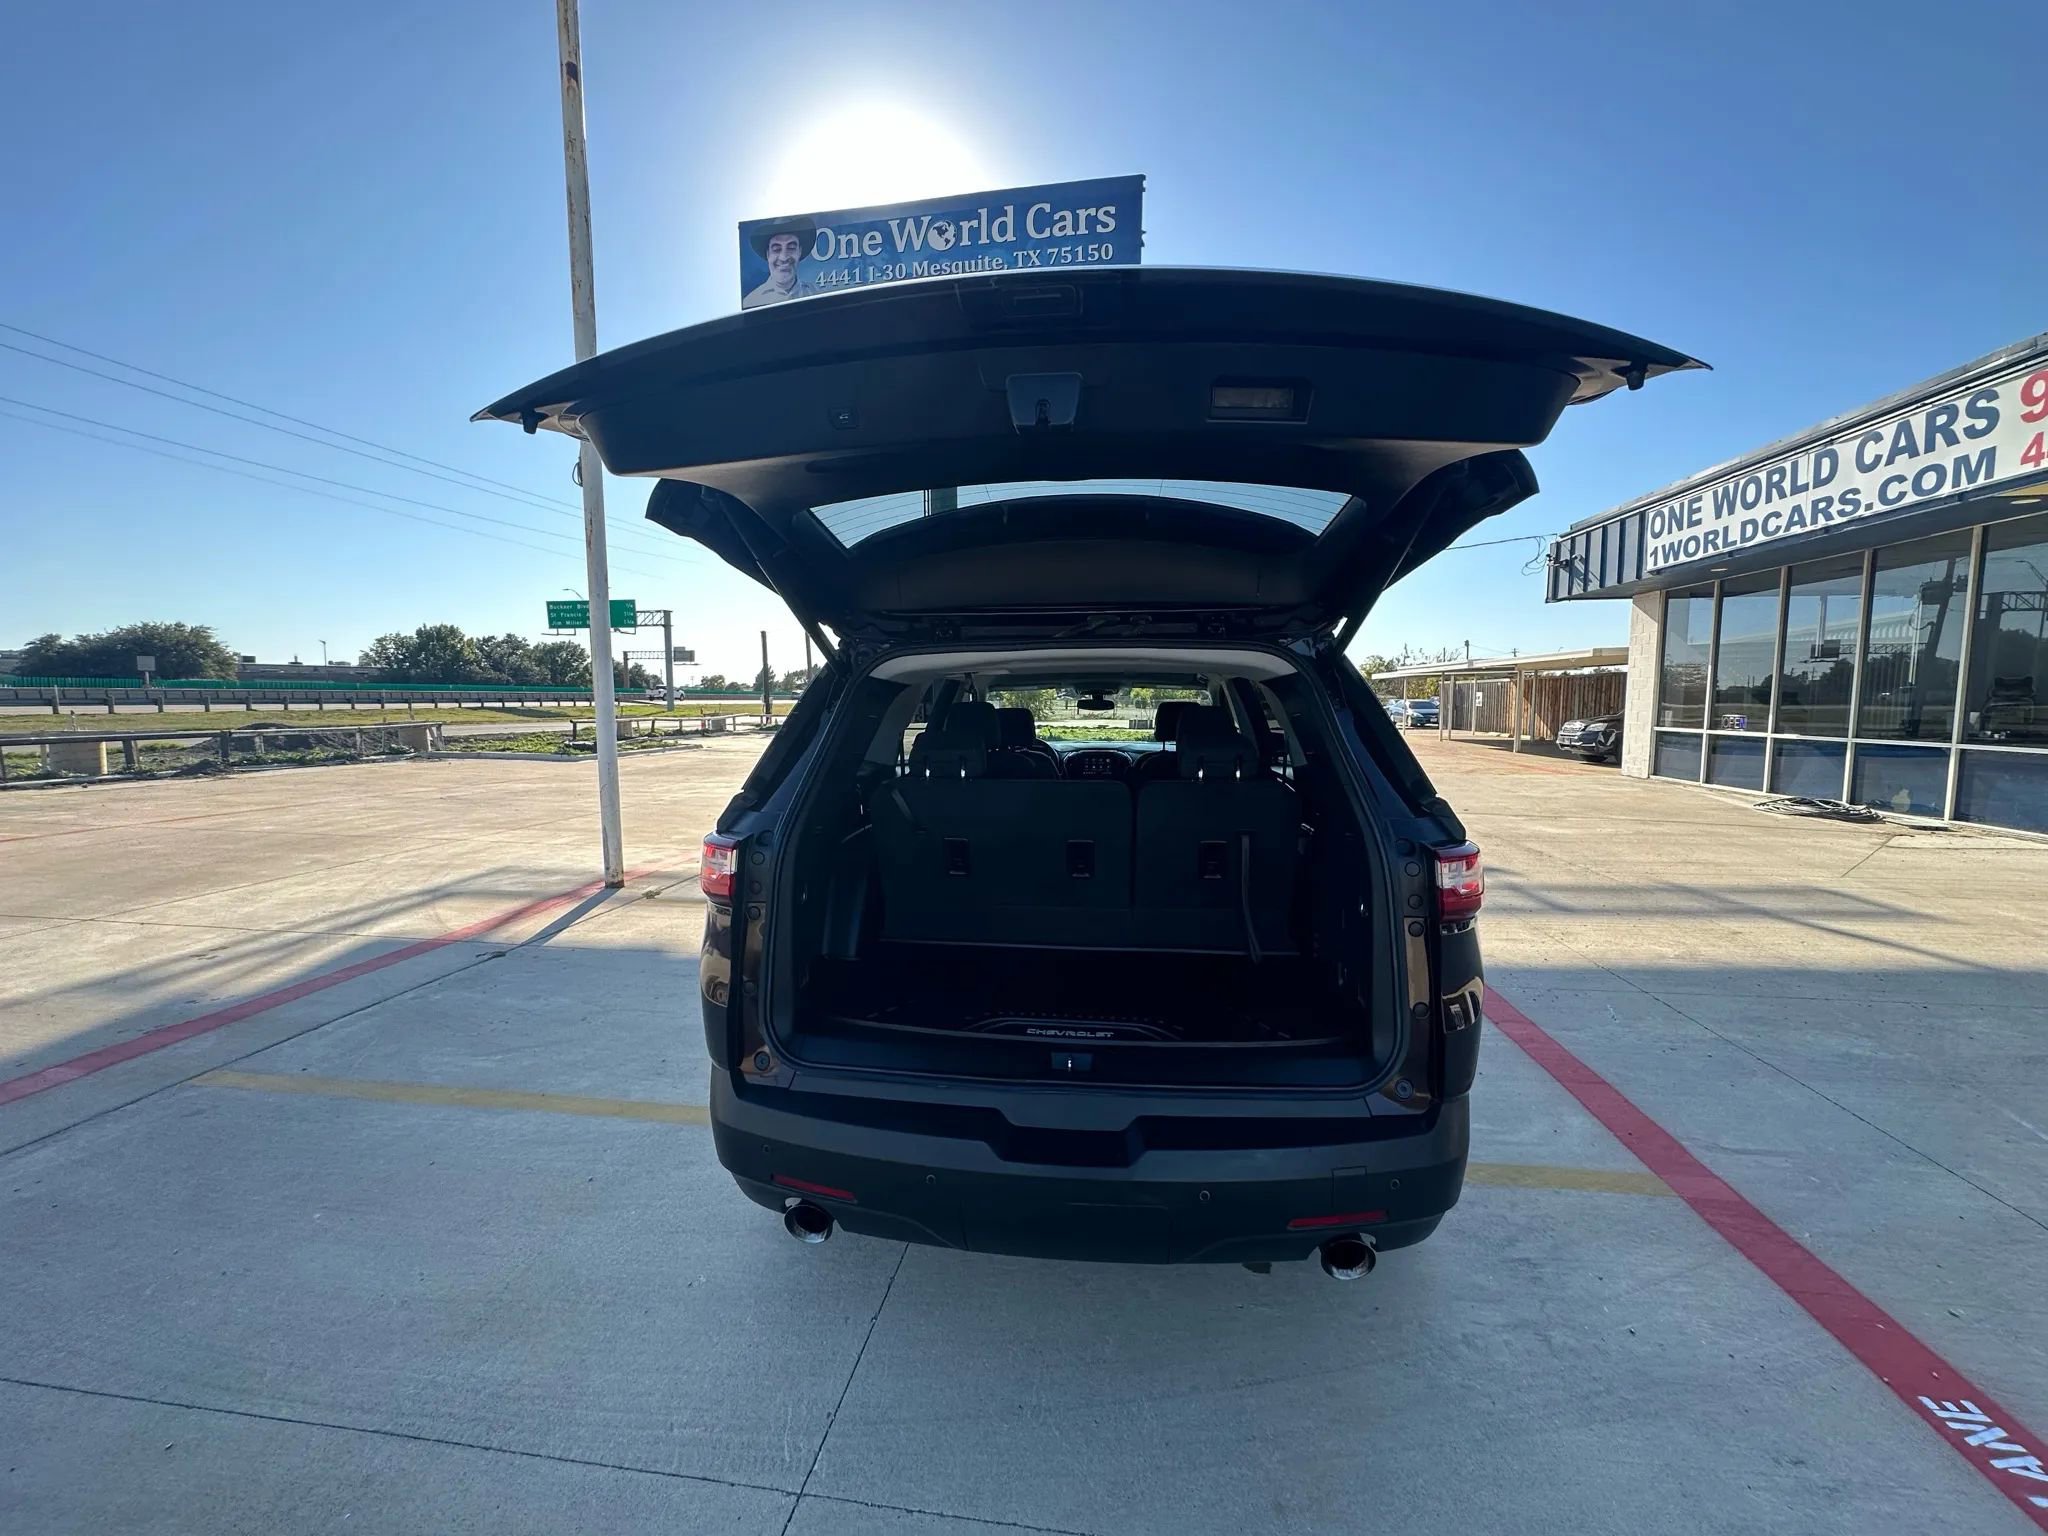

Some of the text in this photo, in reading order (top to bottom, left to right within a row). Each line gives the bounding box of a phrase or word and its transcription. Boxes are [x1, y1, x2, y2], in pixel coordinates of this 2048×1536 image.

[812, 226, 882, 261] One
[1025, 202, 1117, 240] Cars
[815, 243, 1114, 287] 4441 I-30 Mesquite, TX 75150
[1649, 494, 1703, 540] ONE
[1712, 448, 1839, 520] WORLD
[1855, 388, 2001, 474] CARS
[1649, 446, 1997, 568] 1WORLDCARS.COM
[1722, 716, 1745, 729] OPEN
[1026, 1028, 1115, 1038] CHEVROLET
[1917, 1395, 2048, 1509] ANE
